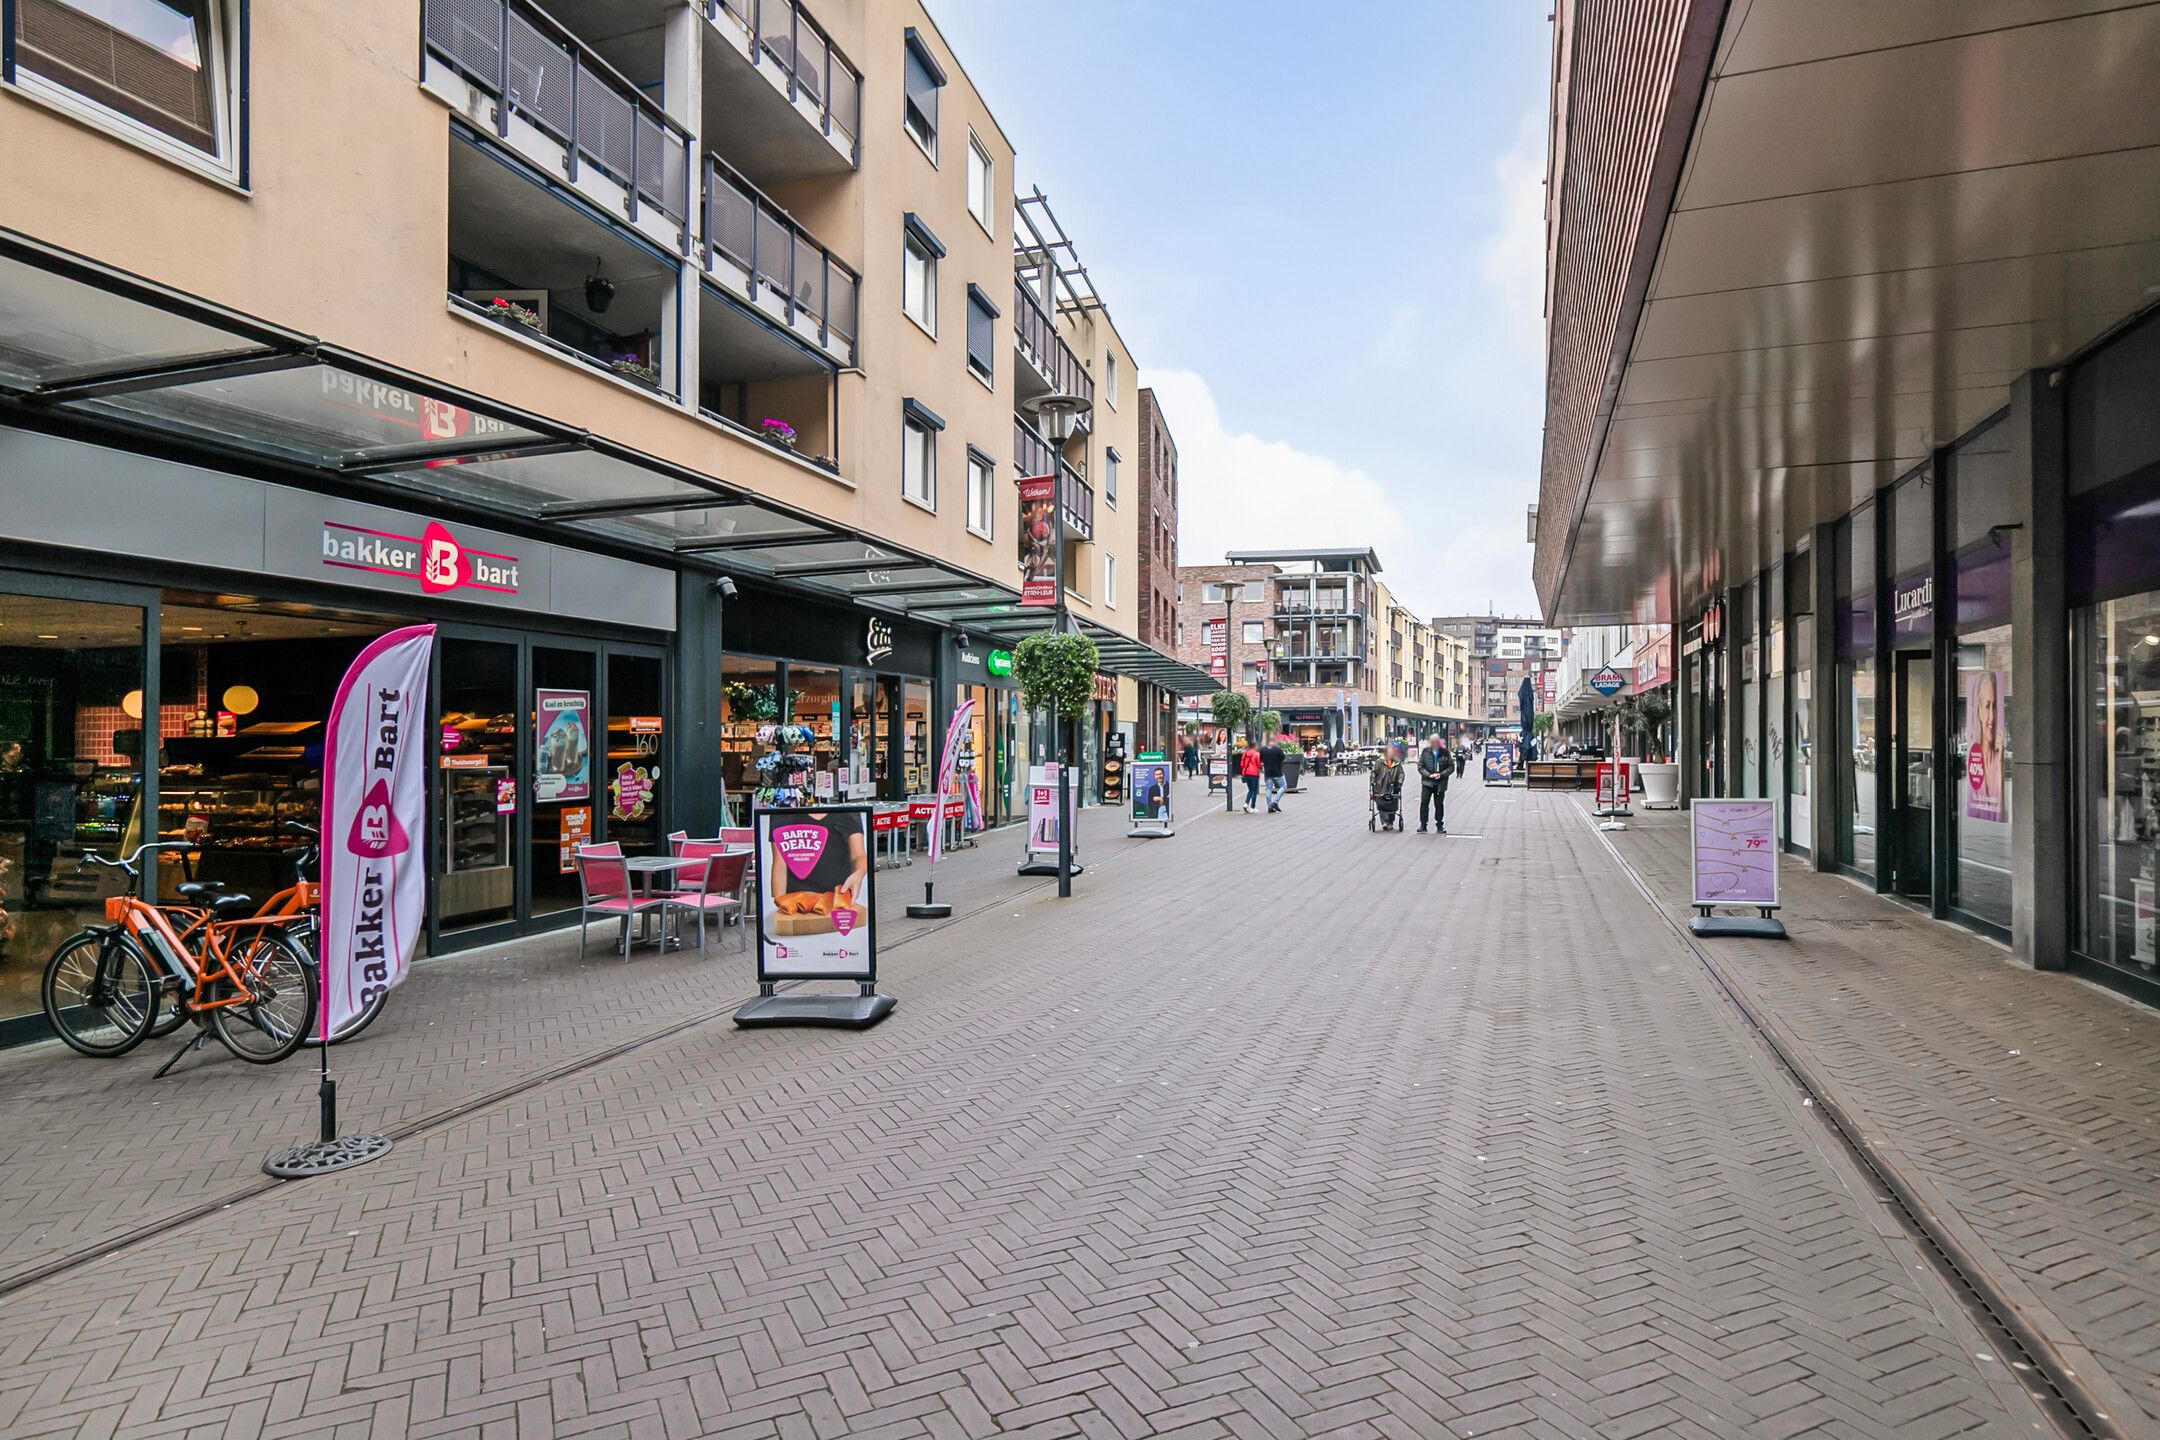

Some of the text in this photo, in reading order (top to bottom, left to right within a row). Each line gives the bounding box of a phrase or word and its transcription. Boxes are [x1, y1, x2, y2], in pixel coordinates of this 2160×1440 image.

[322, 530, 416, 569] bakker
[476, 557, 519, 587] bart
[1894, 577, 1933, 614] Lucardi
[1594, 674, 1621, 682] BRAM
[635, 733, 659, 755] 160
[1969, 762, 1984, 776] 40%
[876, 813, 909, 825] ACTIE ACTIE
[782, 829, 819, 840] BART'S
[354, 866, 389, 1012] Bakker
[373, 687, 402, 772] Bart
[779, 838, 822, 852] DEALS
